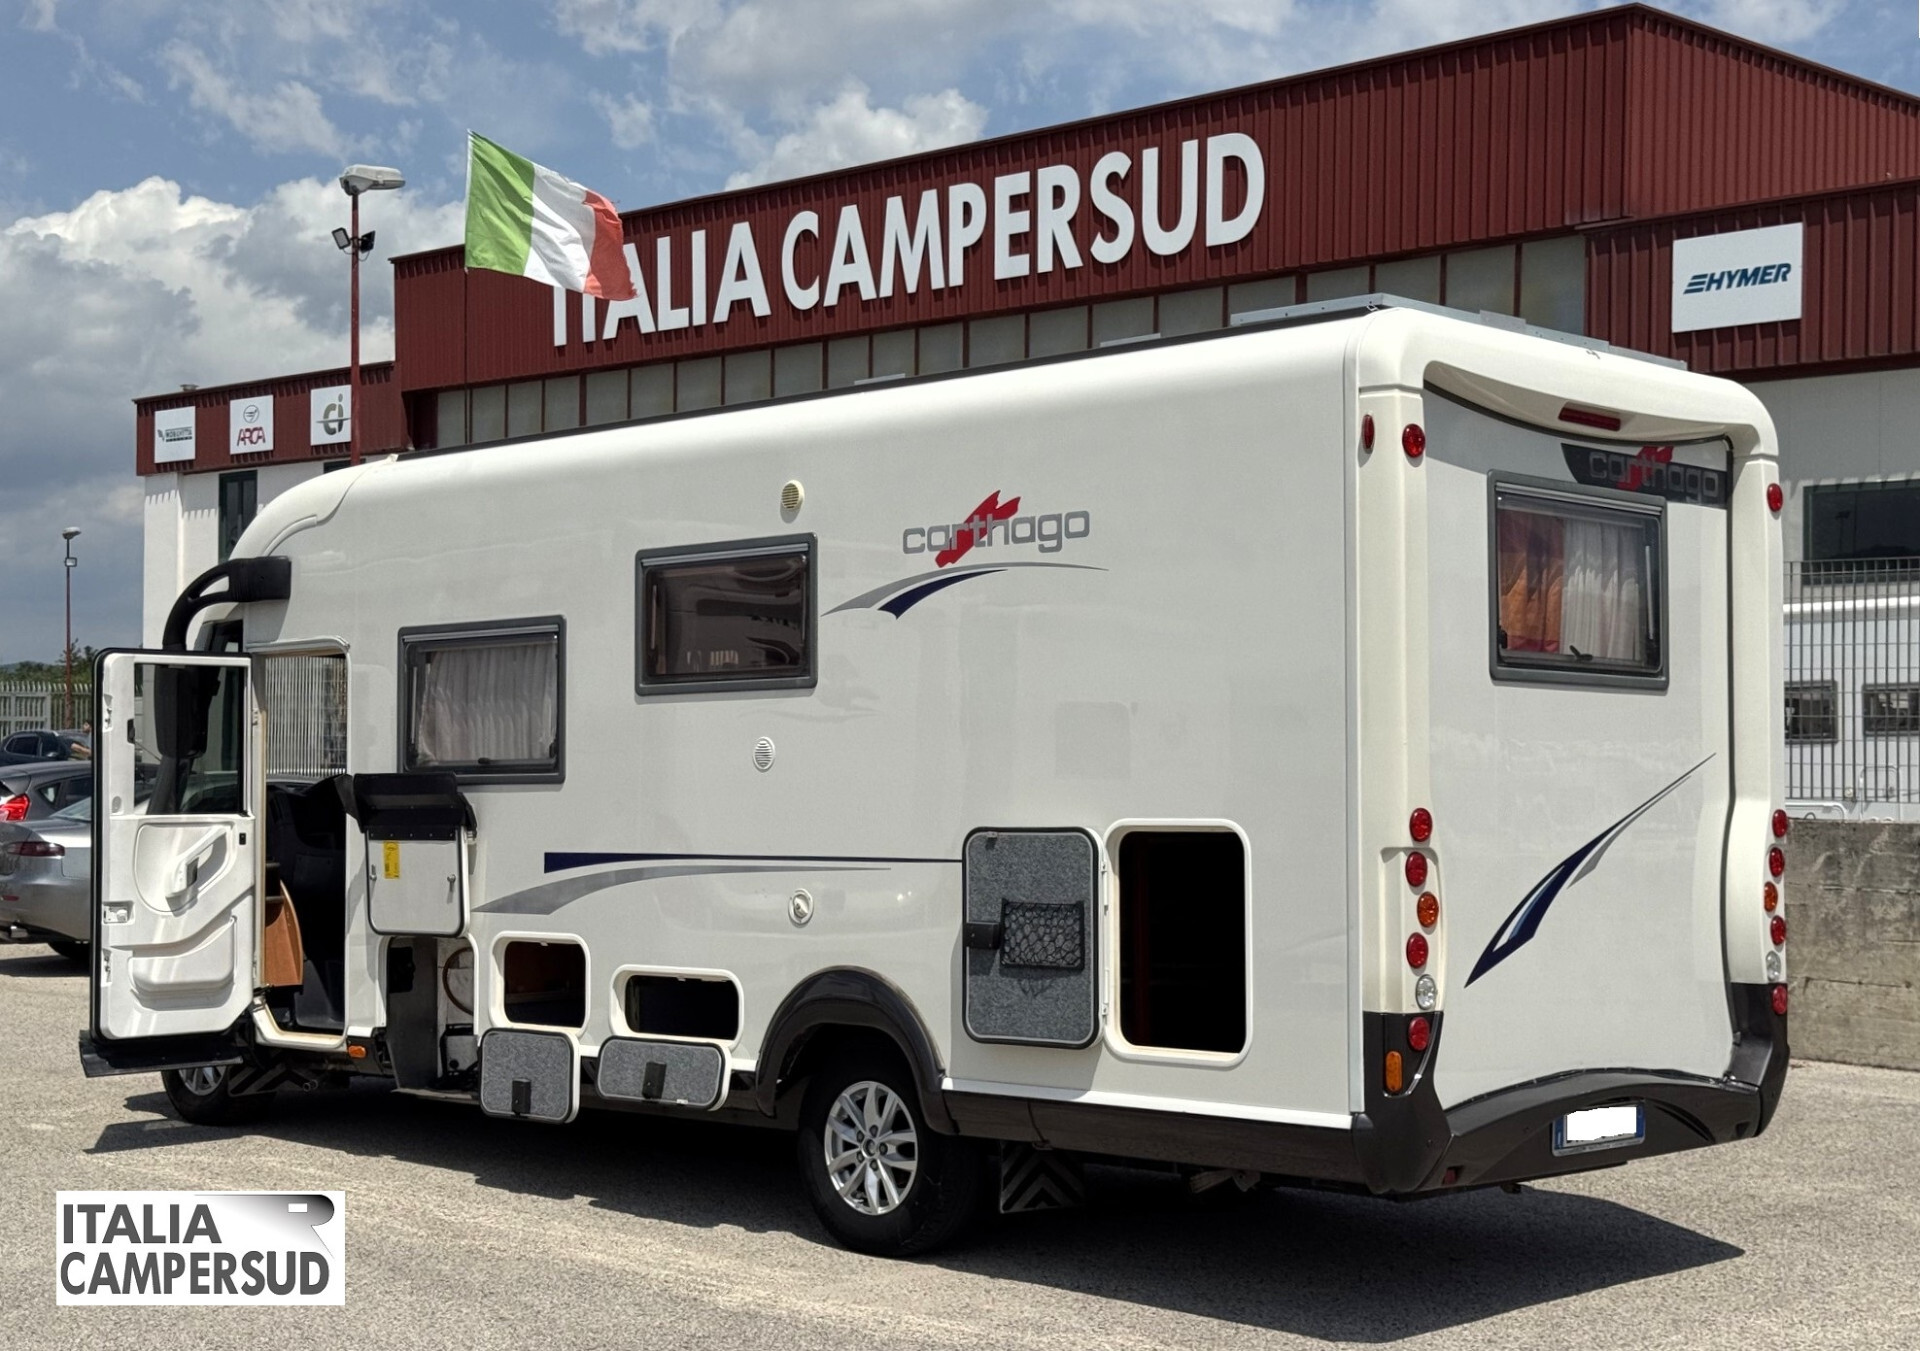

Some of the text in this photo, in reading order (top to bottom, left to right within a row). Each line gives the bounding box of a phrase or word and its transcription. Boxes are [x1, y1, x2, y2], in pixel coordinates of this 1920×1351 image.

[782, 133, 1265, 310] CAMPERSUD
[1700, 263, 1792, 293] HYMER
[237, 426, 266, 446] ARCA
[1589, 452, 1718, 504] carthago
[902, 510, 1090, 553] carthago
